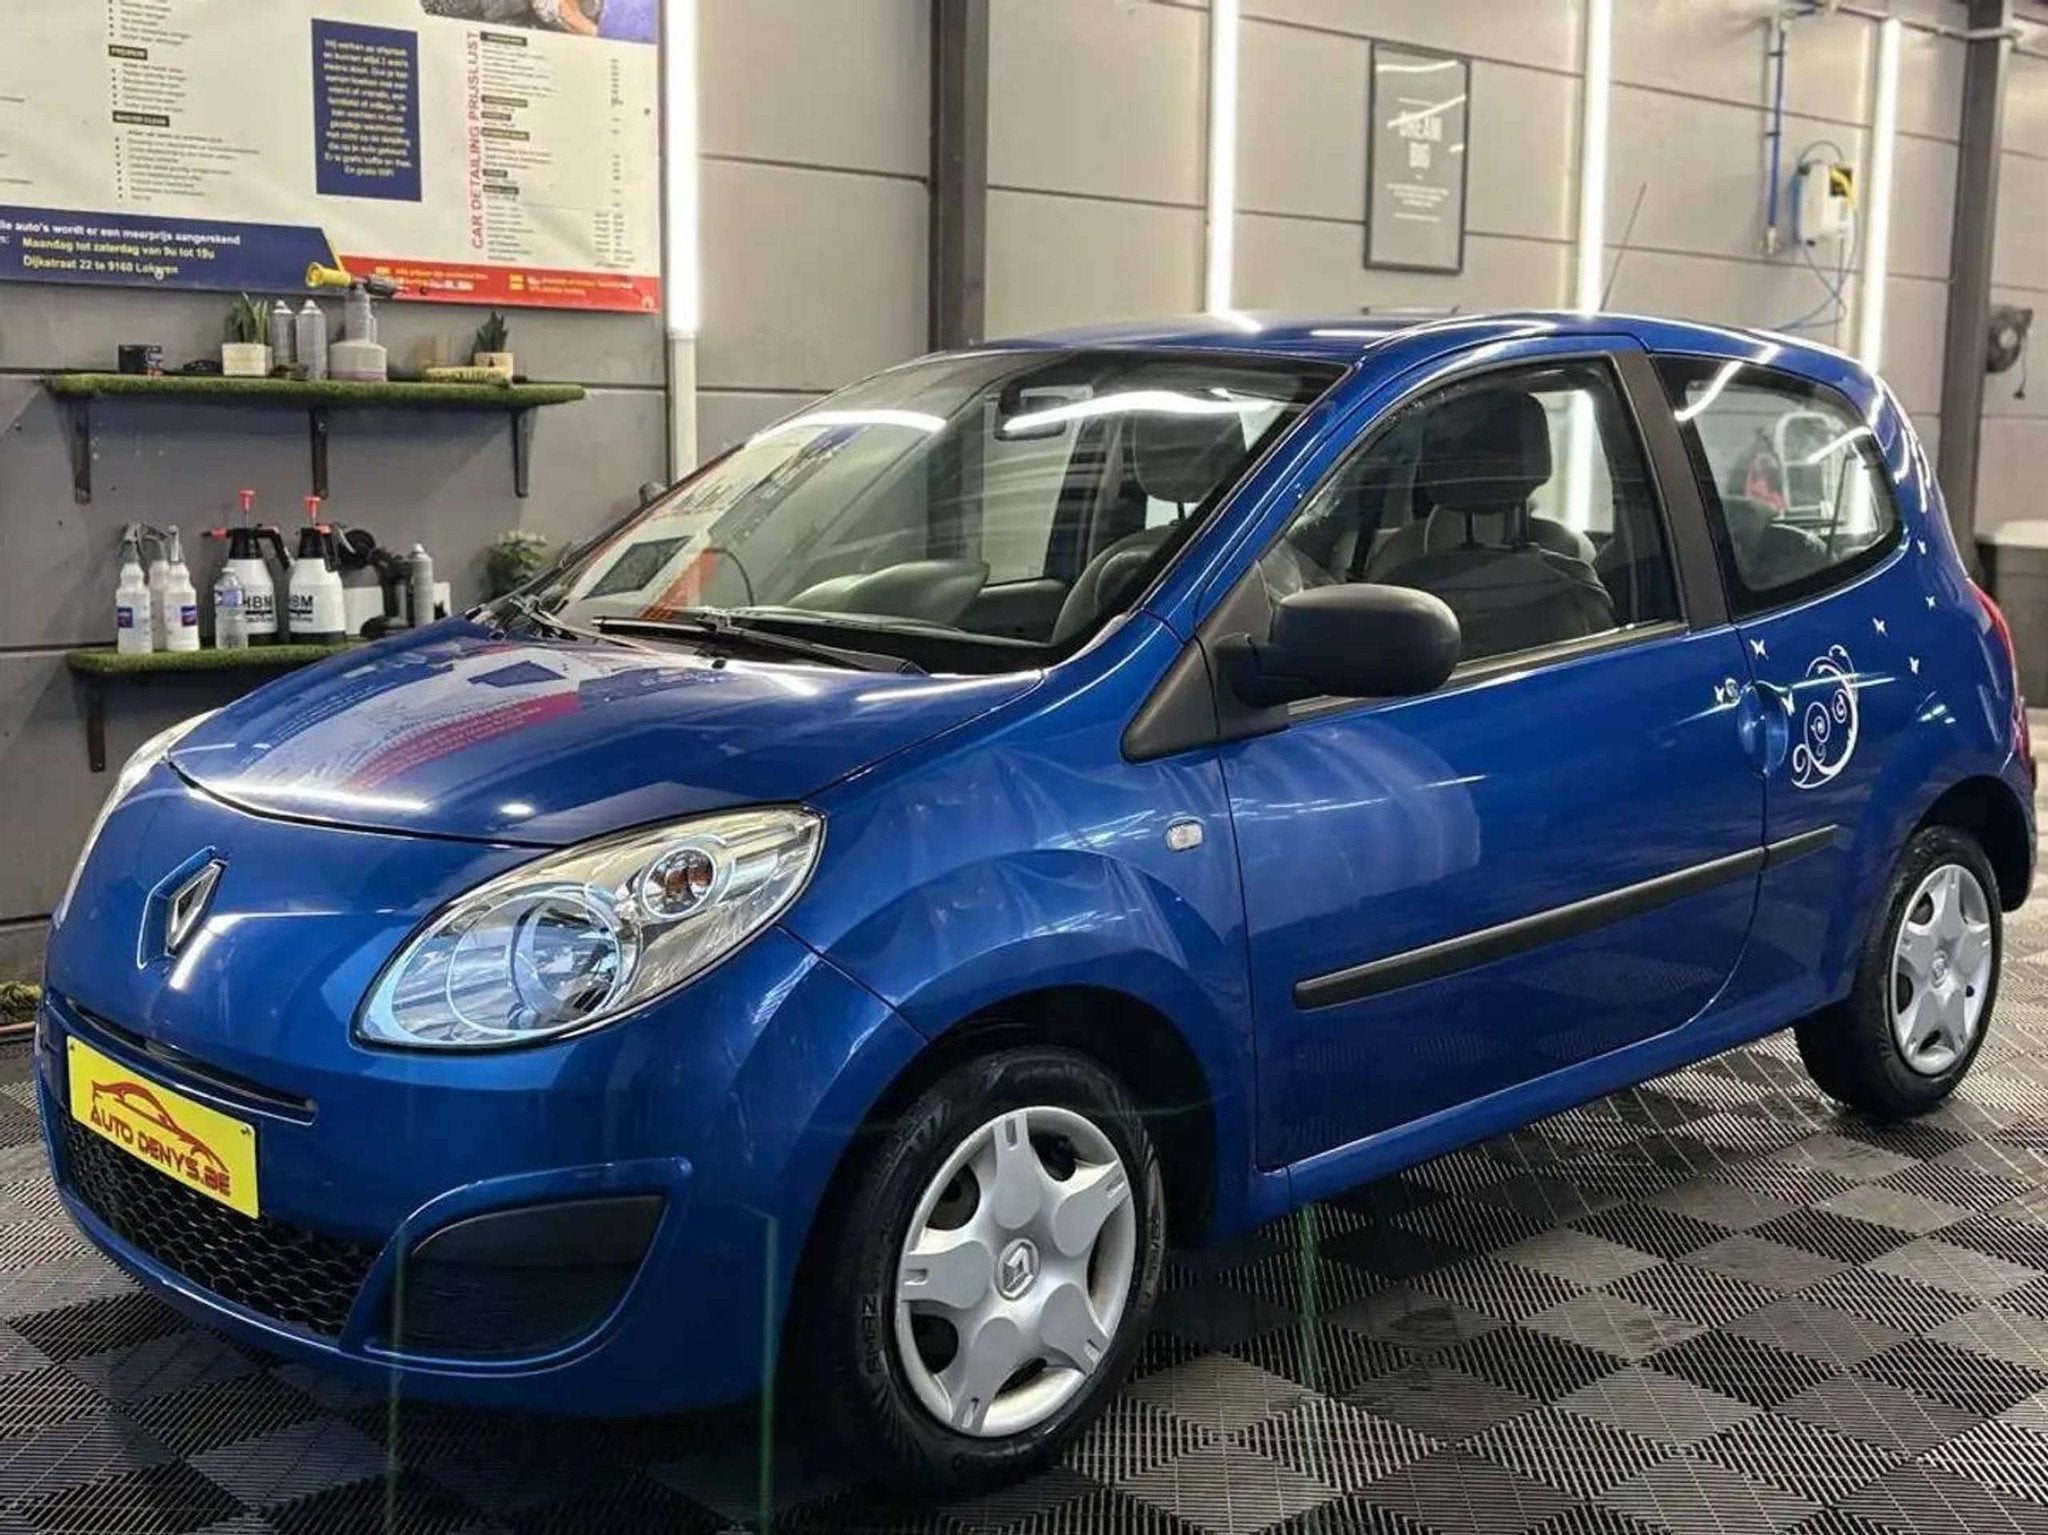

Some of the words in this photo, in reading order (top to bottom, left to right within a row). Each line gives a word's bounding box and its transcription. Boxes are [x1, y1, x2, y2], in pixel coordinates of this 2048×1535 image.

[467, 31, 480, 121] PRIJSLIJST
[468, 126, 482, 211] DETAILING
[15, 222, 50, 232] auto's
[52, 225, 84, 235] wordt
[86, 228, 99, 236] er
[101, 228, 120, 238] een
[122, 230, 172, 243] meerprijs
[471, 215, 484, 250] CAR
[23, 236, 74, 253] Maandag
[76, 241, 91, 251] tot
[93, 243, 139, 256] zaterdag
[142, 246, 162, 256] van
[163, 246, 178, 257] 9u
[179, 247, 194, 258] tot
[23, 255, 77, 269] Dijkstraat
[78, 258, 92, 270] 22
[289, 594, 314, 608] BM
[90, 1104, 134, 1146] AUTO
[137, 1130, 232, 1197] DENYS.BE
